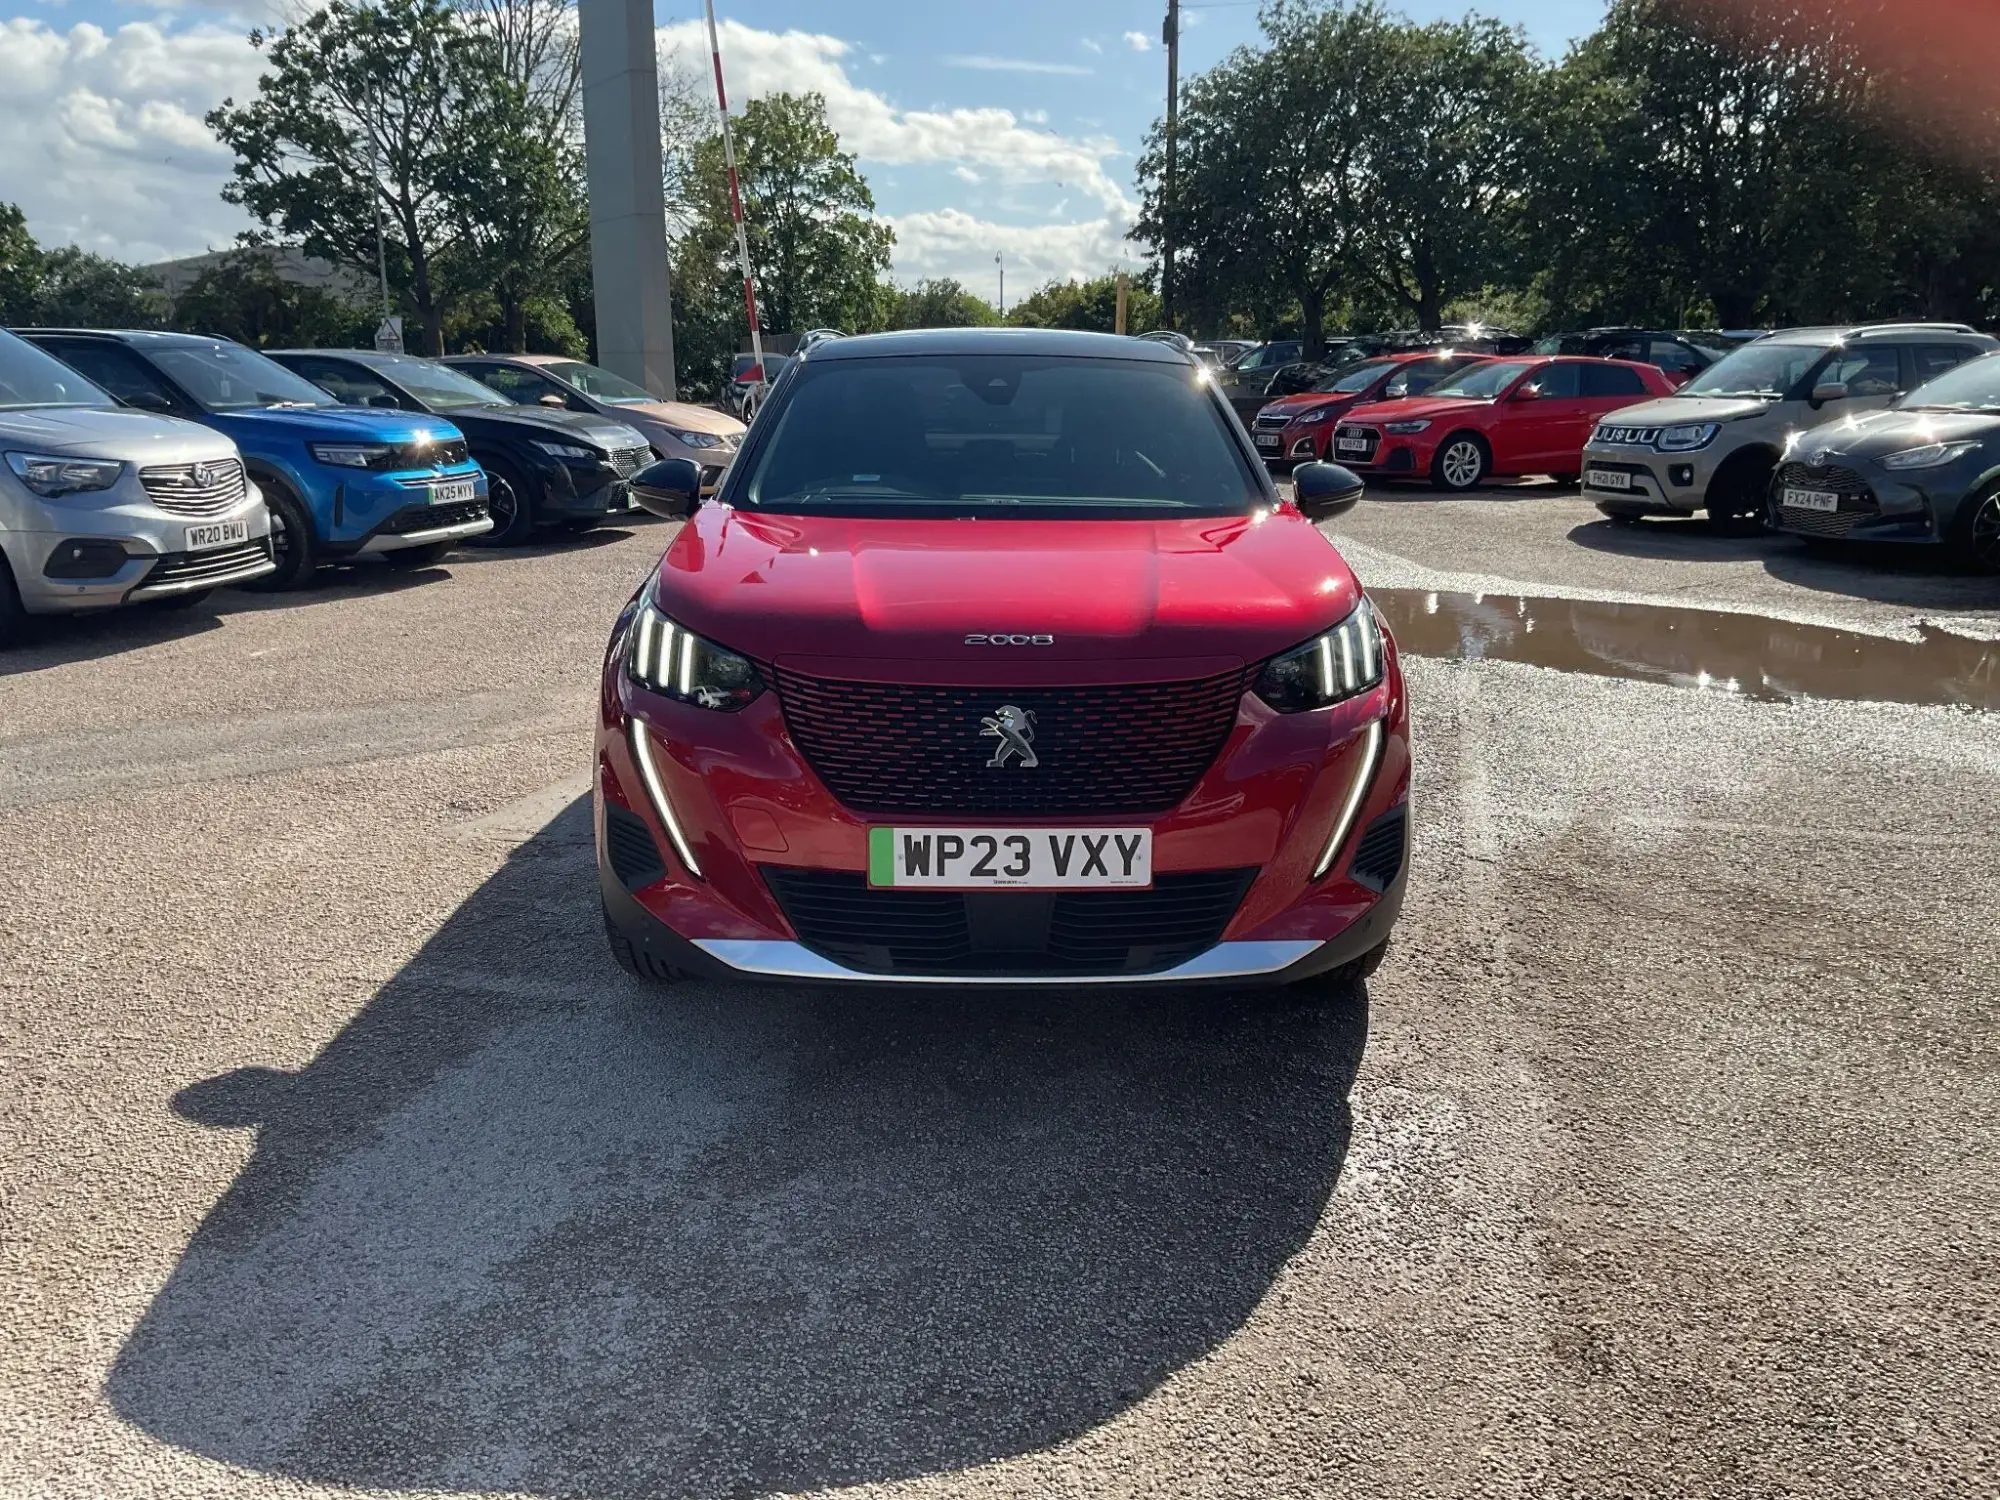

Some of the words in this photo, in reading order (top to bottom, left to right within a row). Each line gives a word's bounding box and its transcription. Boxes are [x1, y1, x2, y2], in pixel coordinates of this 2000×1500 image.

[1610, 474, 1625, 486] GYX
[435, 486, 456, 500] AK25
[457, 484, 472, 498] MYY
[1788, 491, 1812, 505] FX24
[1813, 494, 1833, 508] PNF
[190, 526, 220, 546] WR20
[223, 522, 243, 540] BWU
[965, 634, 1054, 645] 2008
[904, 834, 1031, 877] WP23
[1048, 834, 1142, 877] VXY
